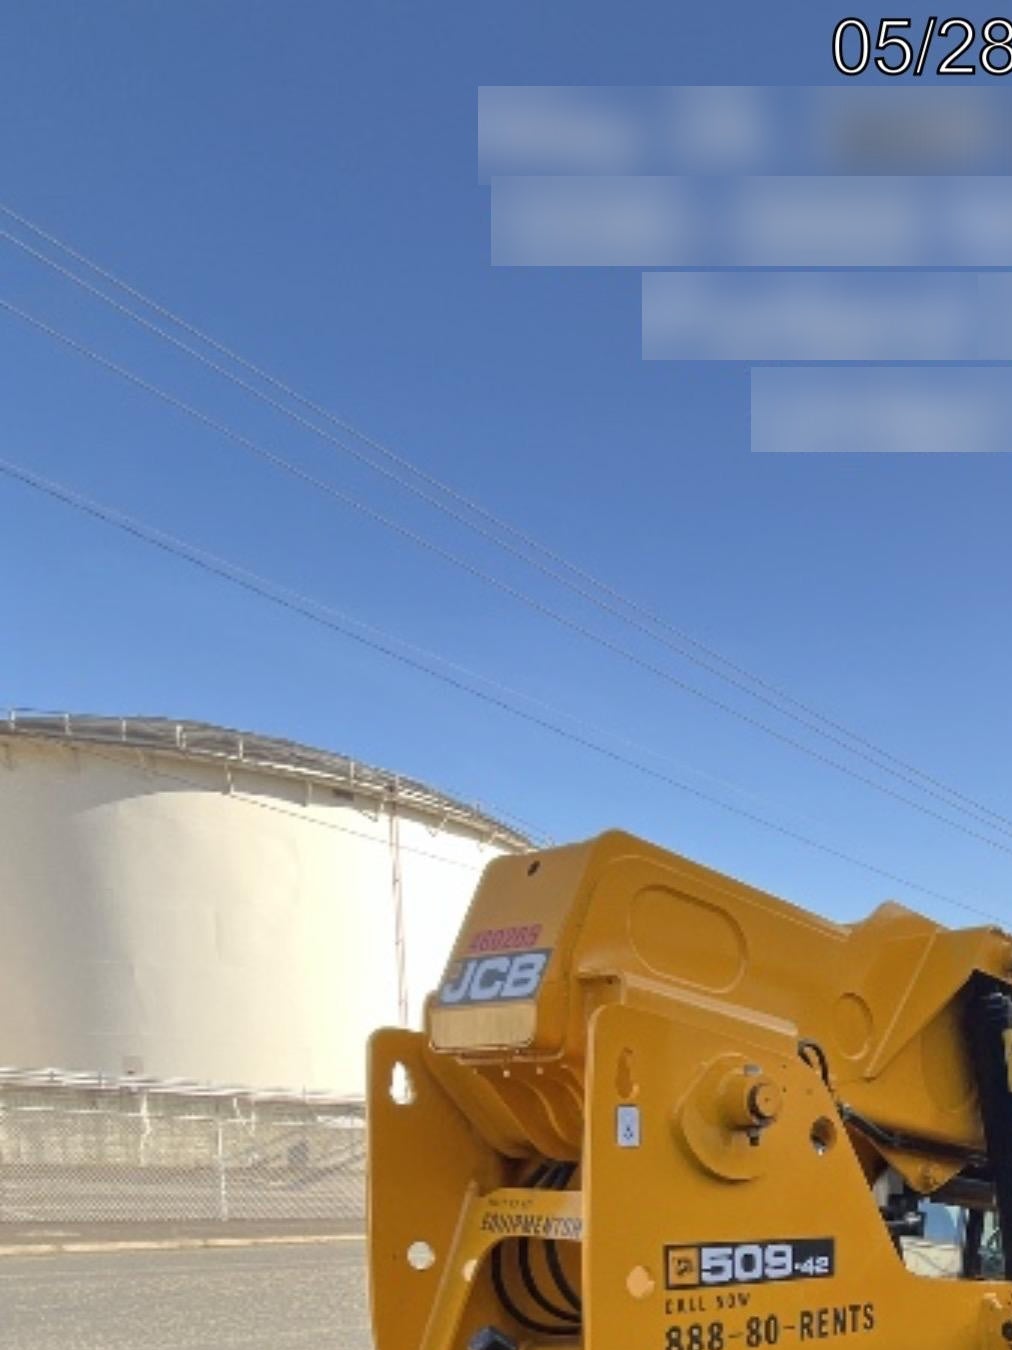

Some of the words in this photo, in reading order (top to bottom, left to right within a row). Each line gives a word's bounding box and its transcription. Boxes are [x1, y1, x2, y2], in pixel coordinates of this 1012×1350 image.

[441, 953, 548, 1003] JCB
[665, 1296, 707, 1315] CALL
[716, 1292, 751, 1309] NOW
